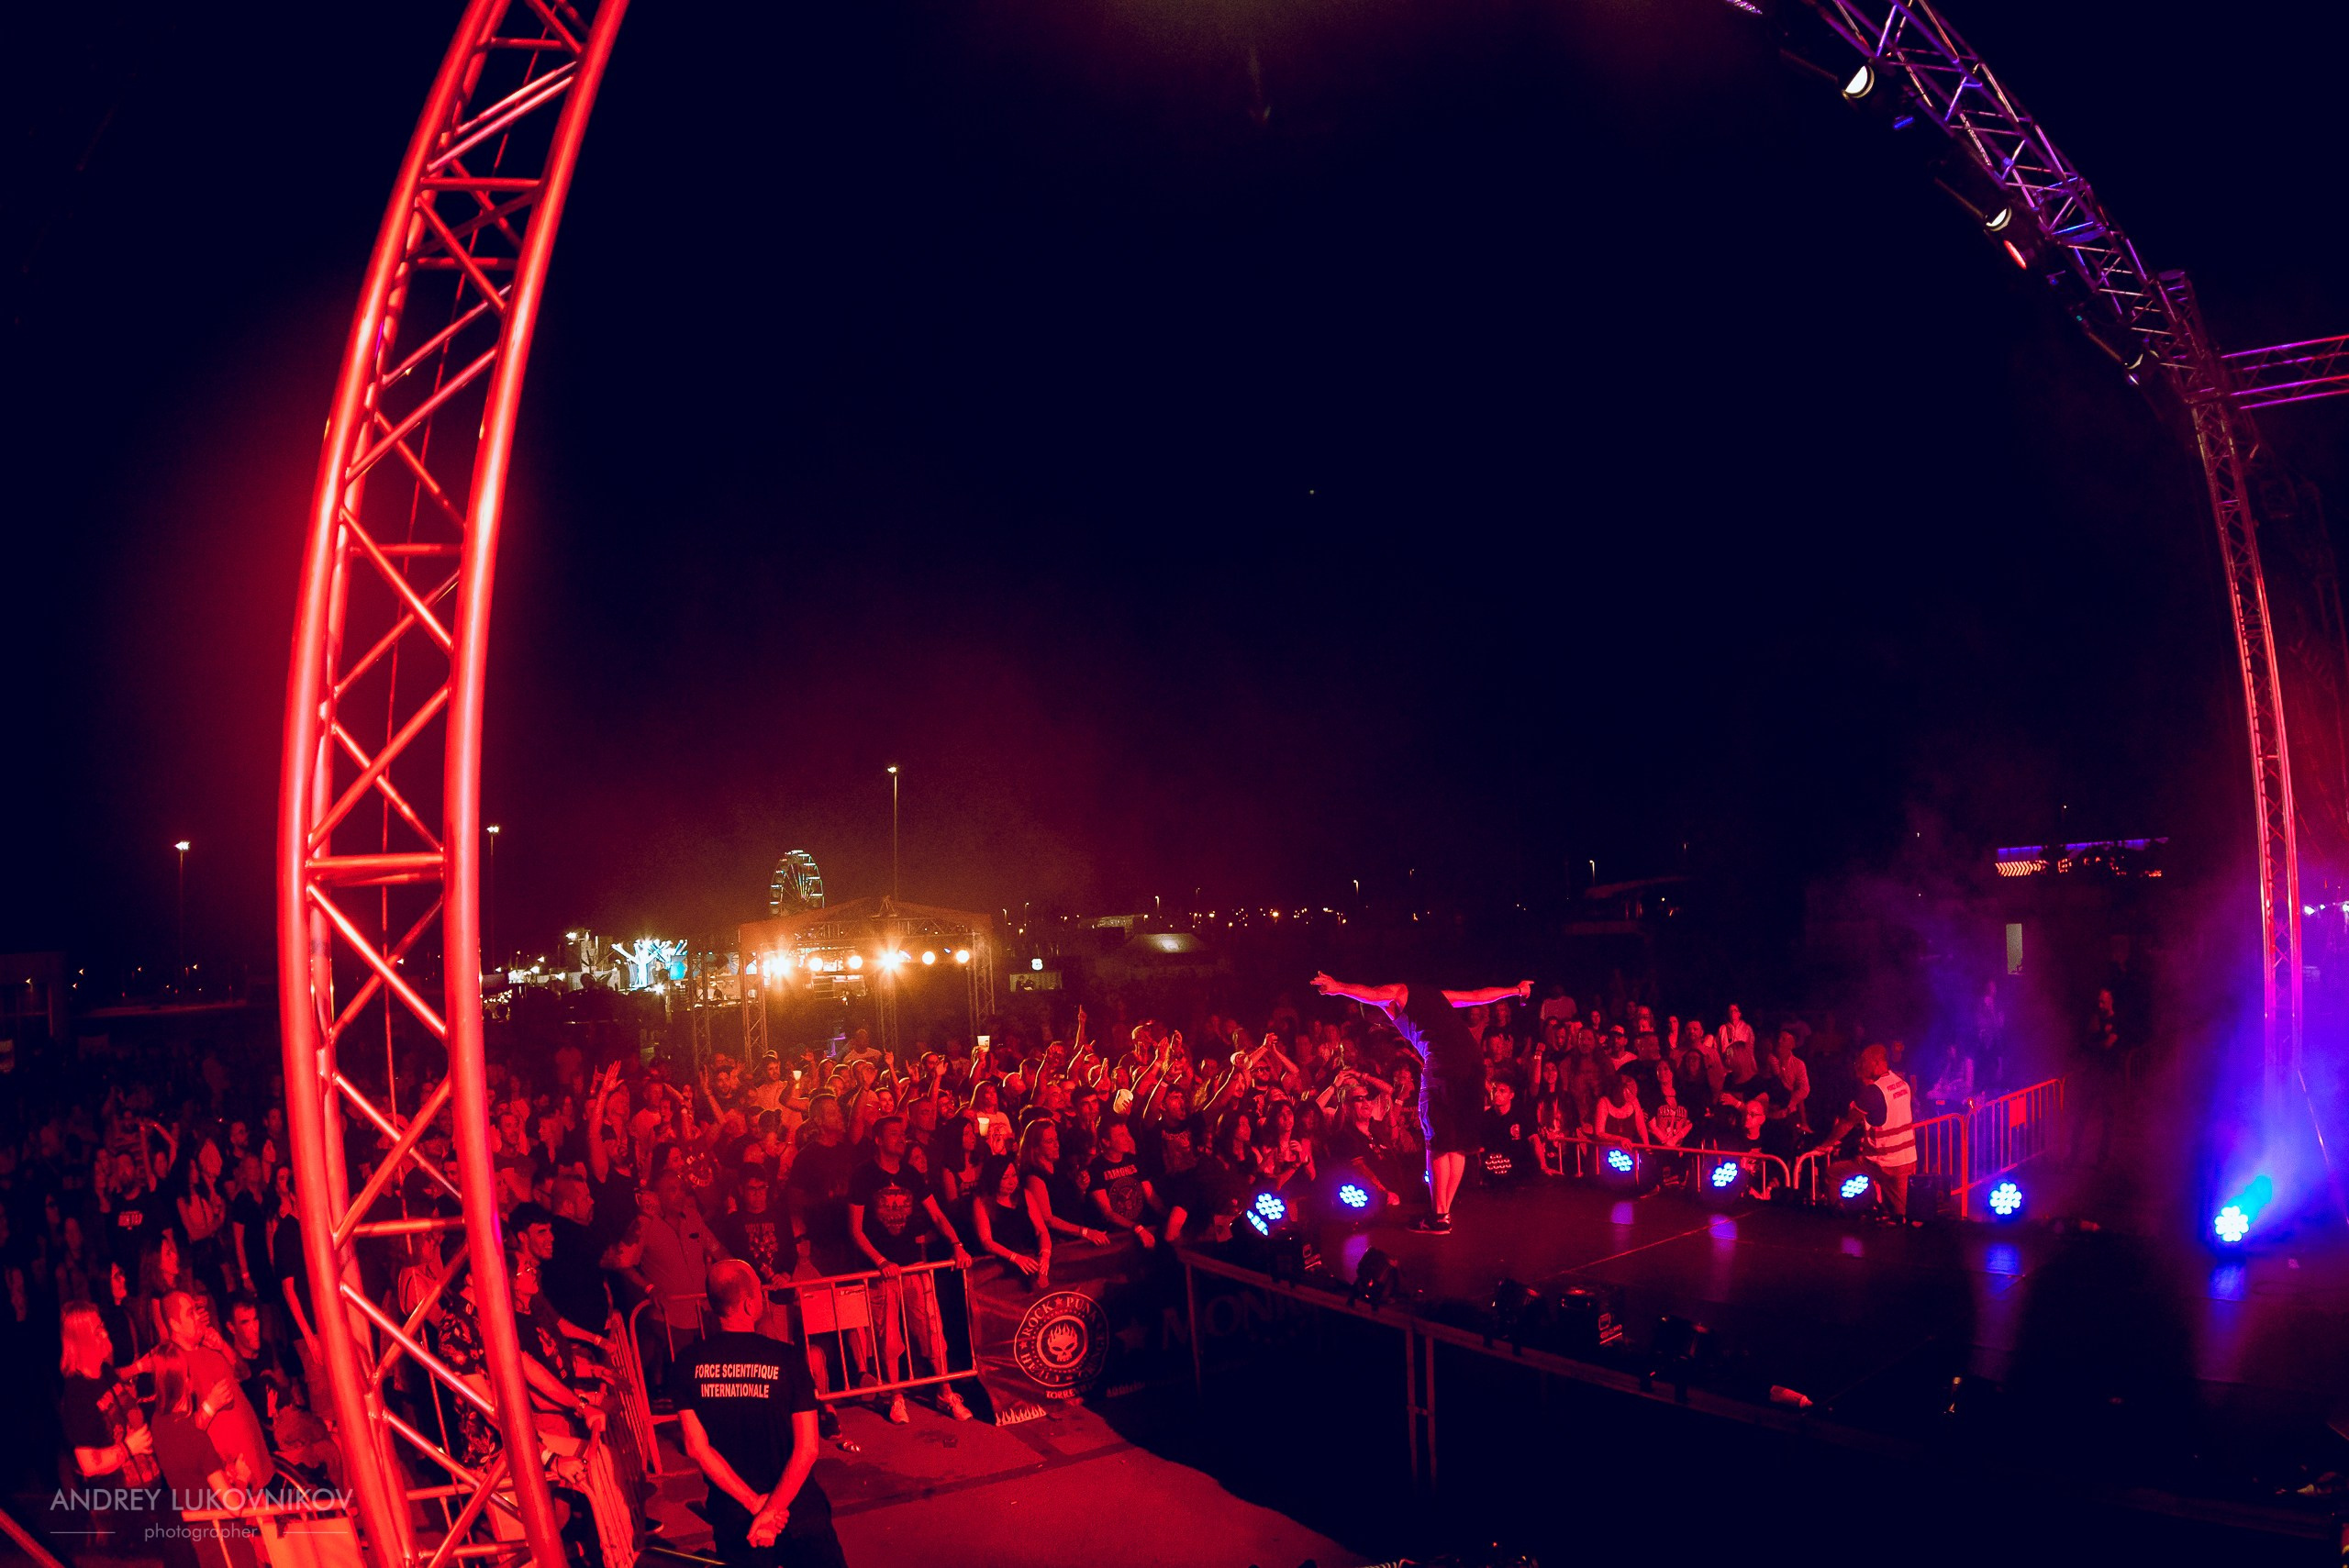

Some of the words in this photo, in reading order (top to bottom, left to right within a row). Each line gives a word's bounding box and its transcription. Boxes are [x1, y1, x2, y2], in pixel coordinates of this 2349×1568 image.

[1021, 1301, 1054, 1337] ROCK
[1065, 1296, 1097, 1322] PUNK
[695, 1363, 720, 1379] FORCE
[722, 1363, 779, 1380] SCIENTIFIQUE
[701, 1383, 770, 1399] INTERNATIONALE
